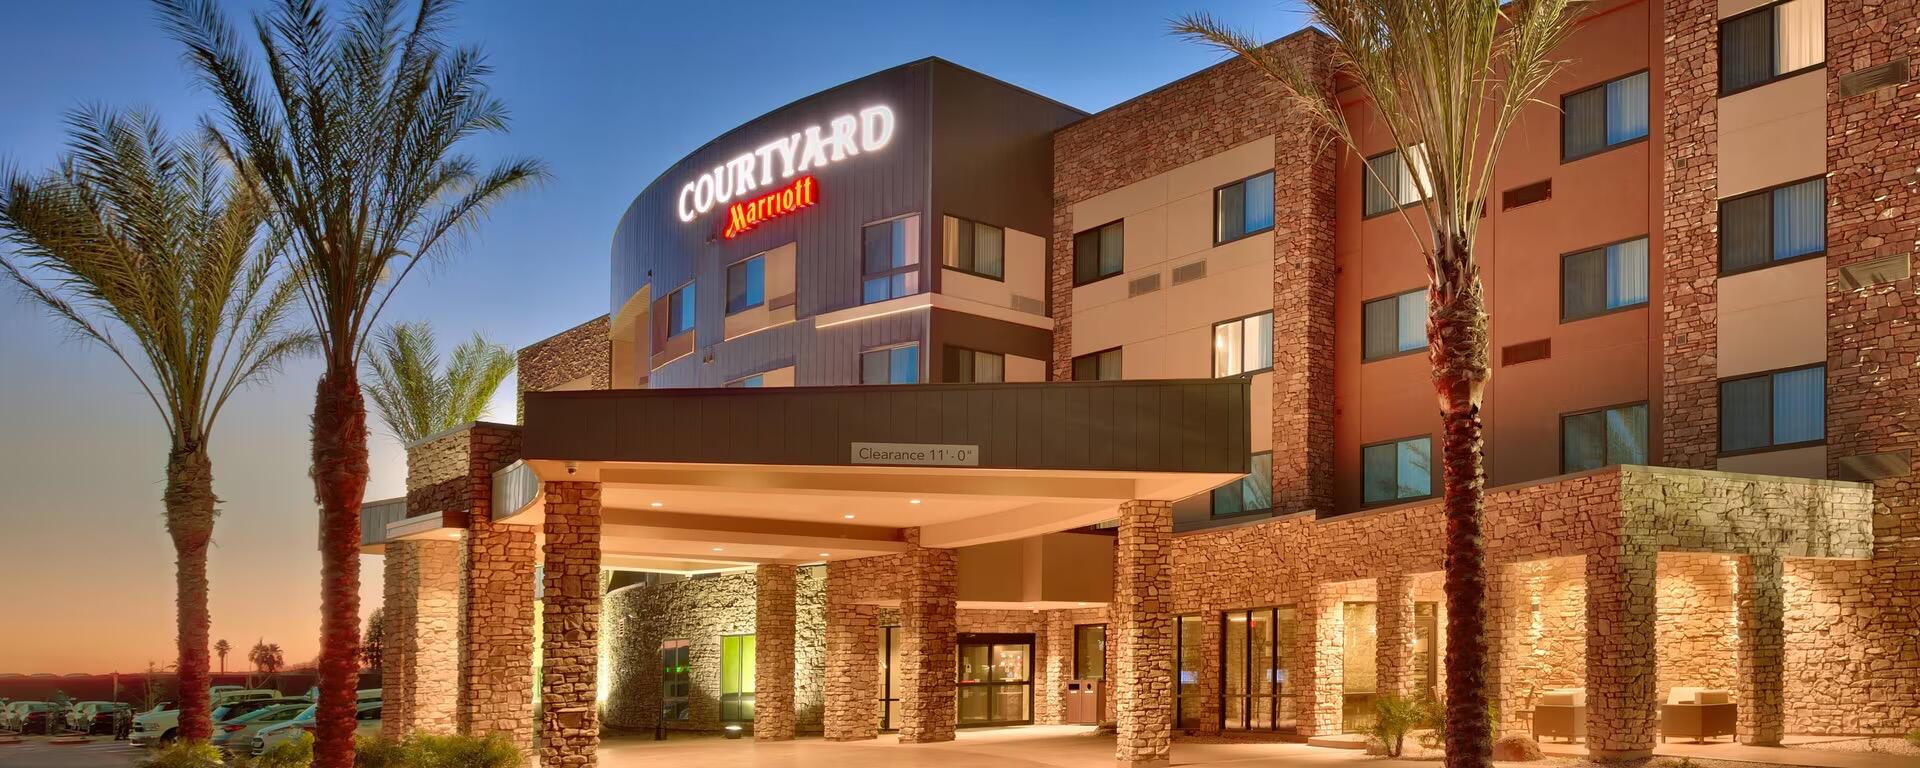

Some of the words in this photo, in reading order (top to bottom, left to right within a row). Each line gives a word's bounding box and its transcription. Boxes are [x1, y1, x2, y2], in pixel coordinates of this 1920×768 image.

[678, 105, 895, 223] COURTYARD
[725, 175, 816, 237] Marriott
[859, 447, 924, 461] Clearance
